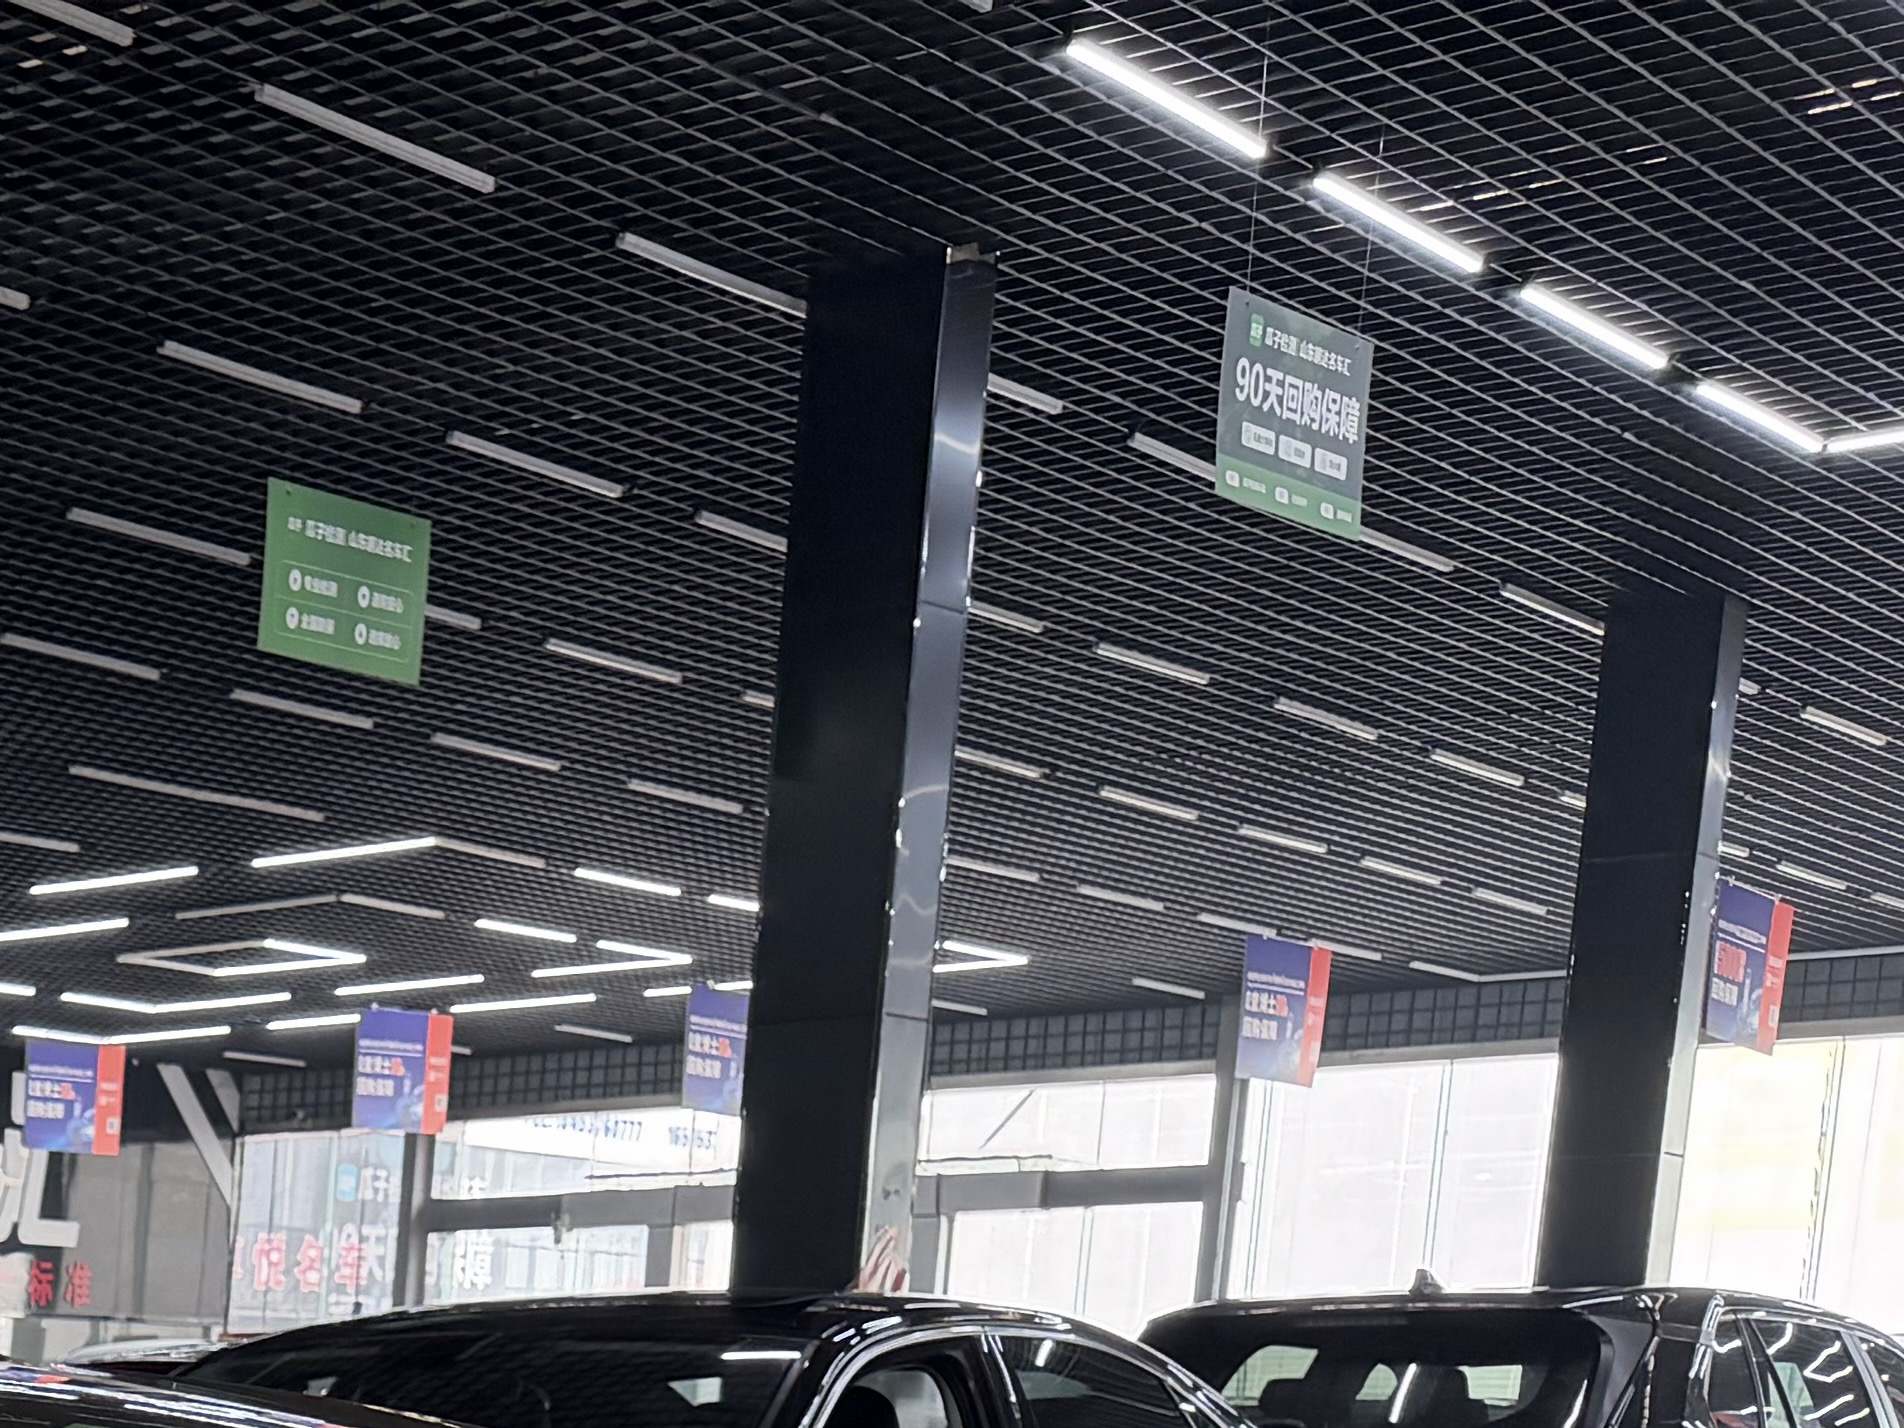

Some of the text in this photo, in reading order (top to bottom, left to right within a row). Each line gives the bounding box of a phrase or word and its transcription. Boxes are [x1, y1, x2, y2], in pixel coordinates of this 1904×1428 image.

[1235, 356, 1360, 444] 90天回购保障
